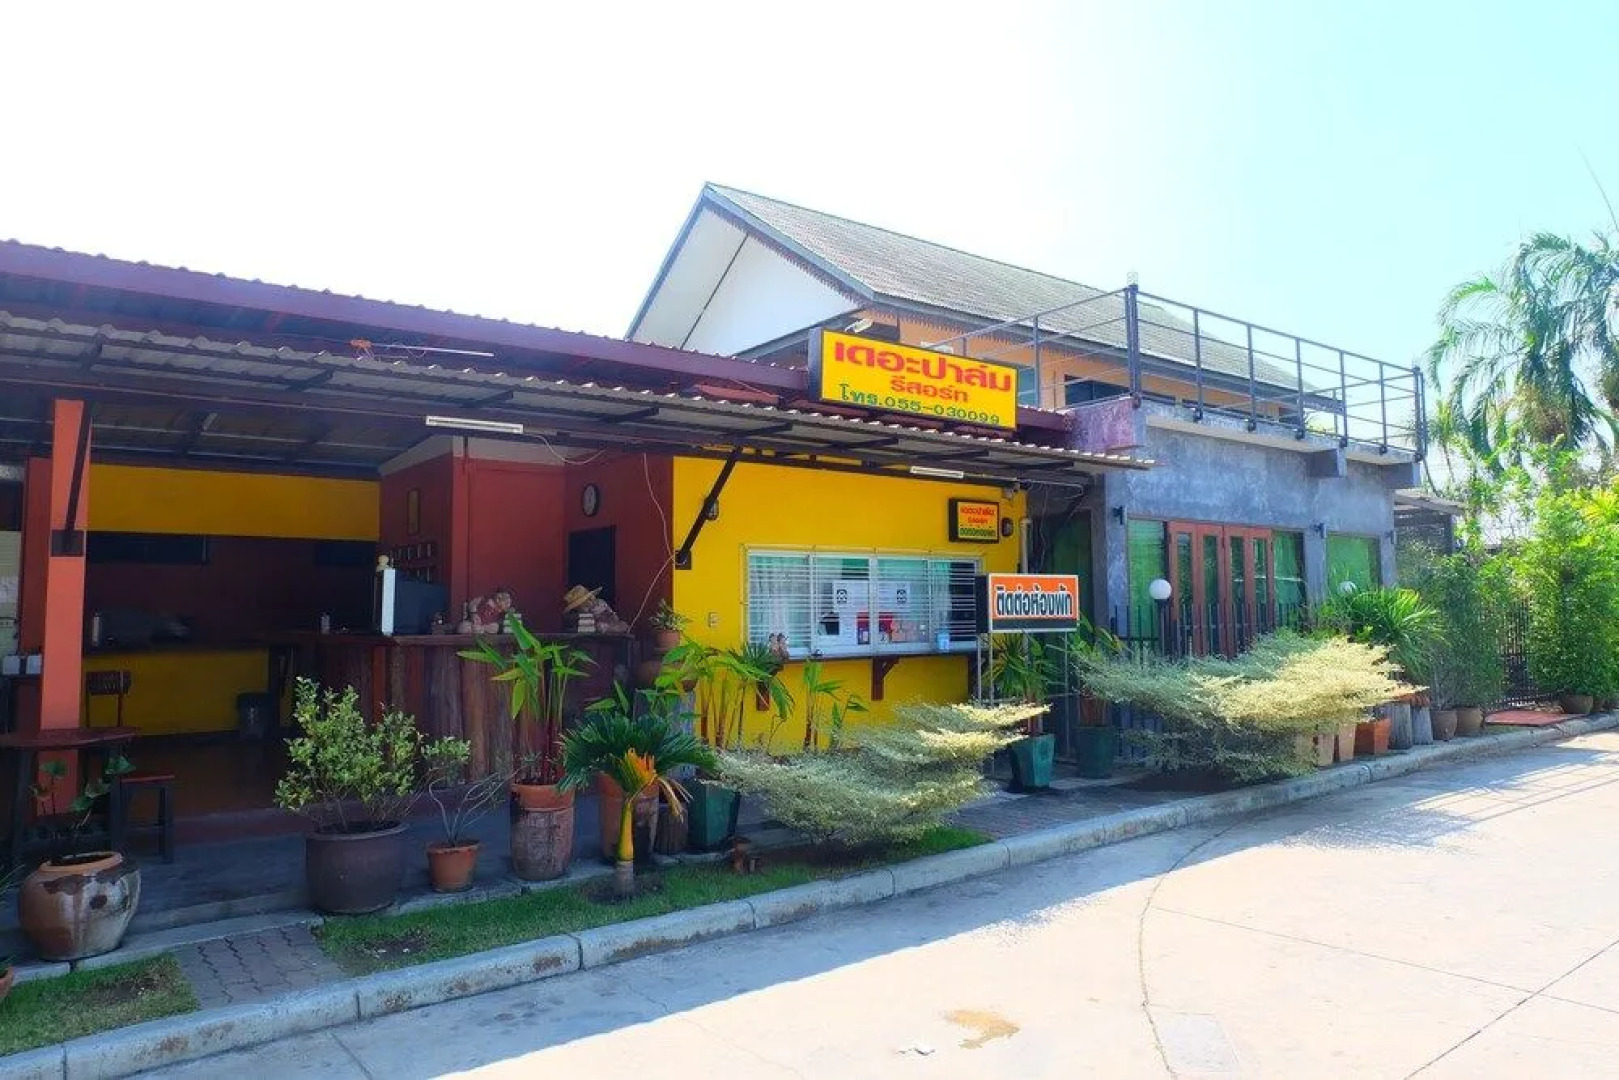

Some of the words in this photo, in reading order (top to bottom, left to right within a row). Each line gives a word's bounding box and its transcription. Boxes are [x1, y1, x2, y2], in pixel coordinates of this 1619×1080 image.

[834, 341, 1011, 392] เดอะปาล์ม
[996, 584, 1072, 616] ติดต่อห้องพัก
